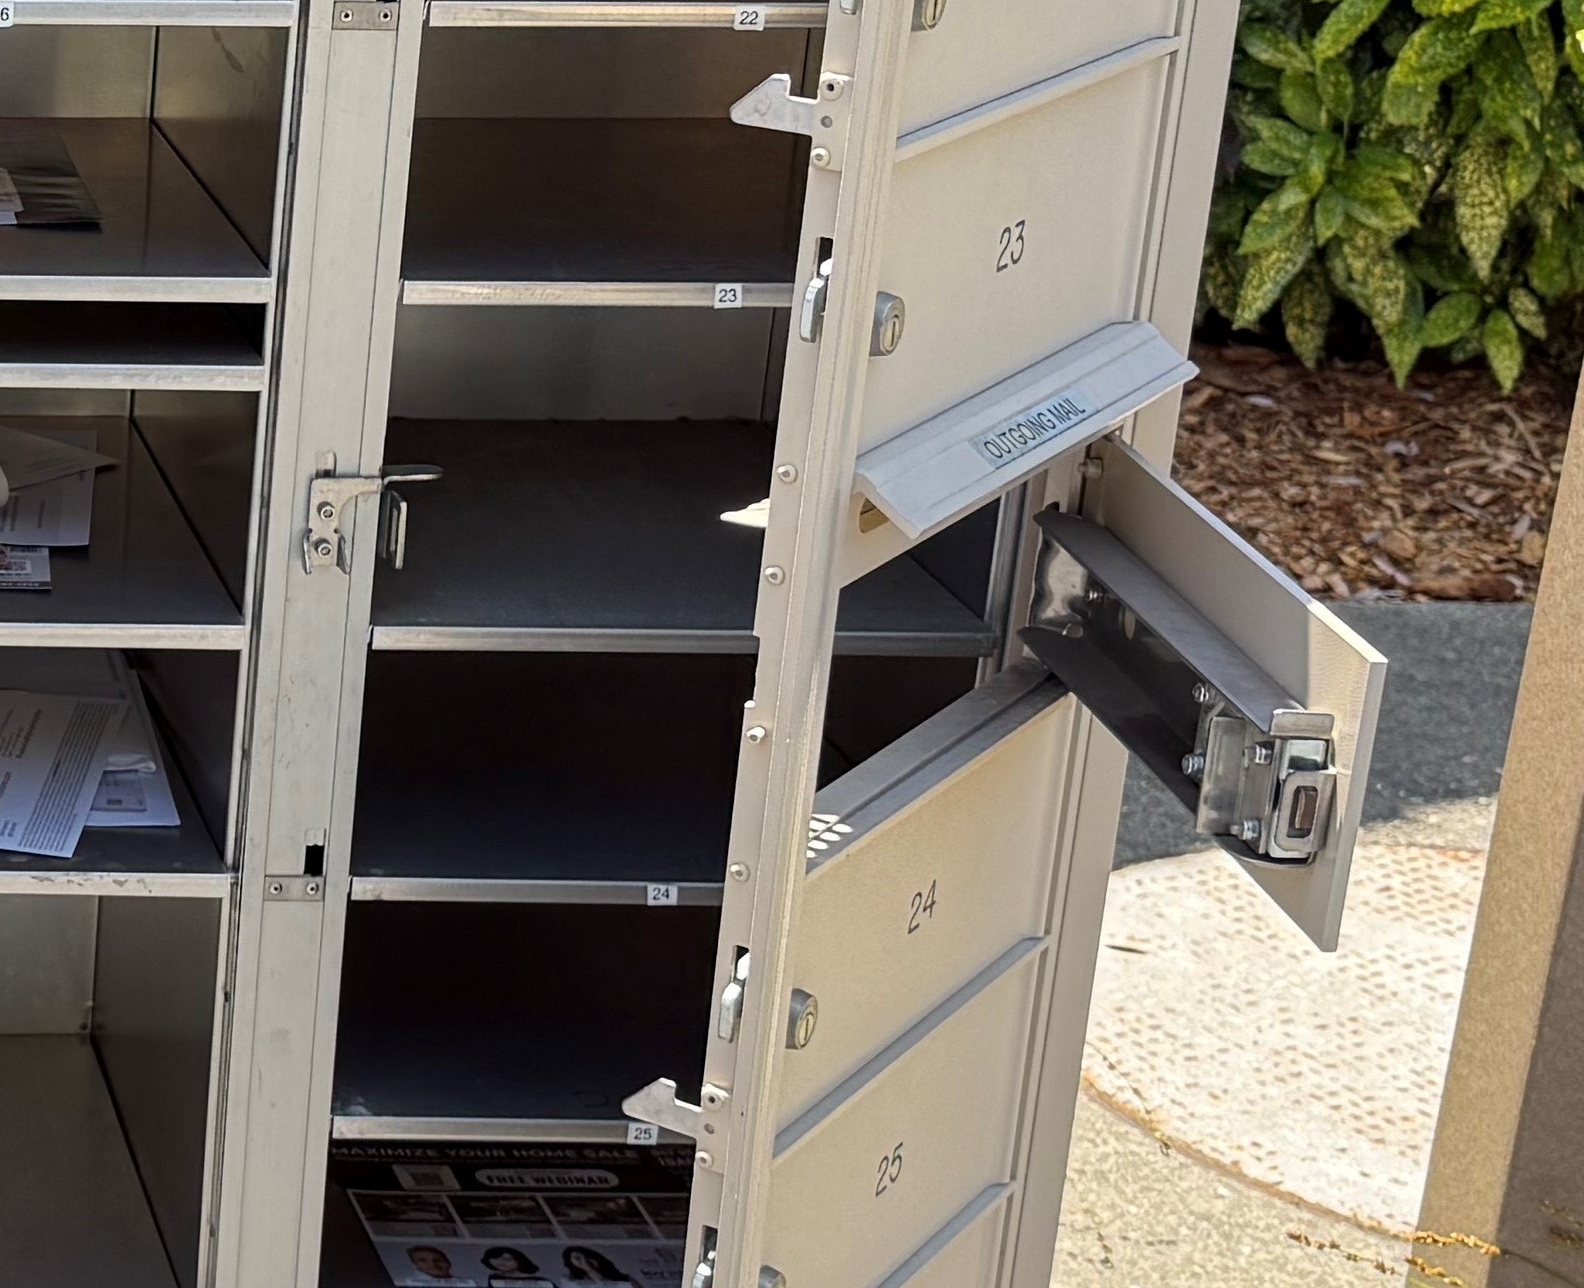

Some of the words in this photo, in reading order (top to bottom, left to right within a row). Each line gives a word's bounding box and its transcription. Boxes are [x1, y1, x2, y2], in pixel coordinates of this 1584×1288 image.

[738, 10, 759, 26] 22
[995, 219, 1026, 273] 23
[718, 288, 738, 303] 23
[983, 411, 1057, 459] OUTGOING
[1047, 398, 1087, 425] MAIL
[652, 886, 670, 901] 24
[907, 879, 937, 935] 24
[633, 1127, 653, 1141] 25
[331, 1145, 439, 1160] MAXIMIZE
[446, 1146, 507, 1160] YOUR
[511, 1146, 575, 1161] HOME
[875, 1141, 904, 1198] 25
